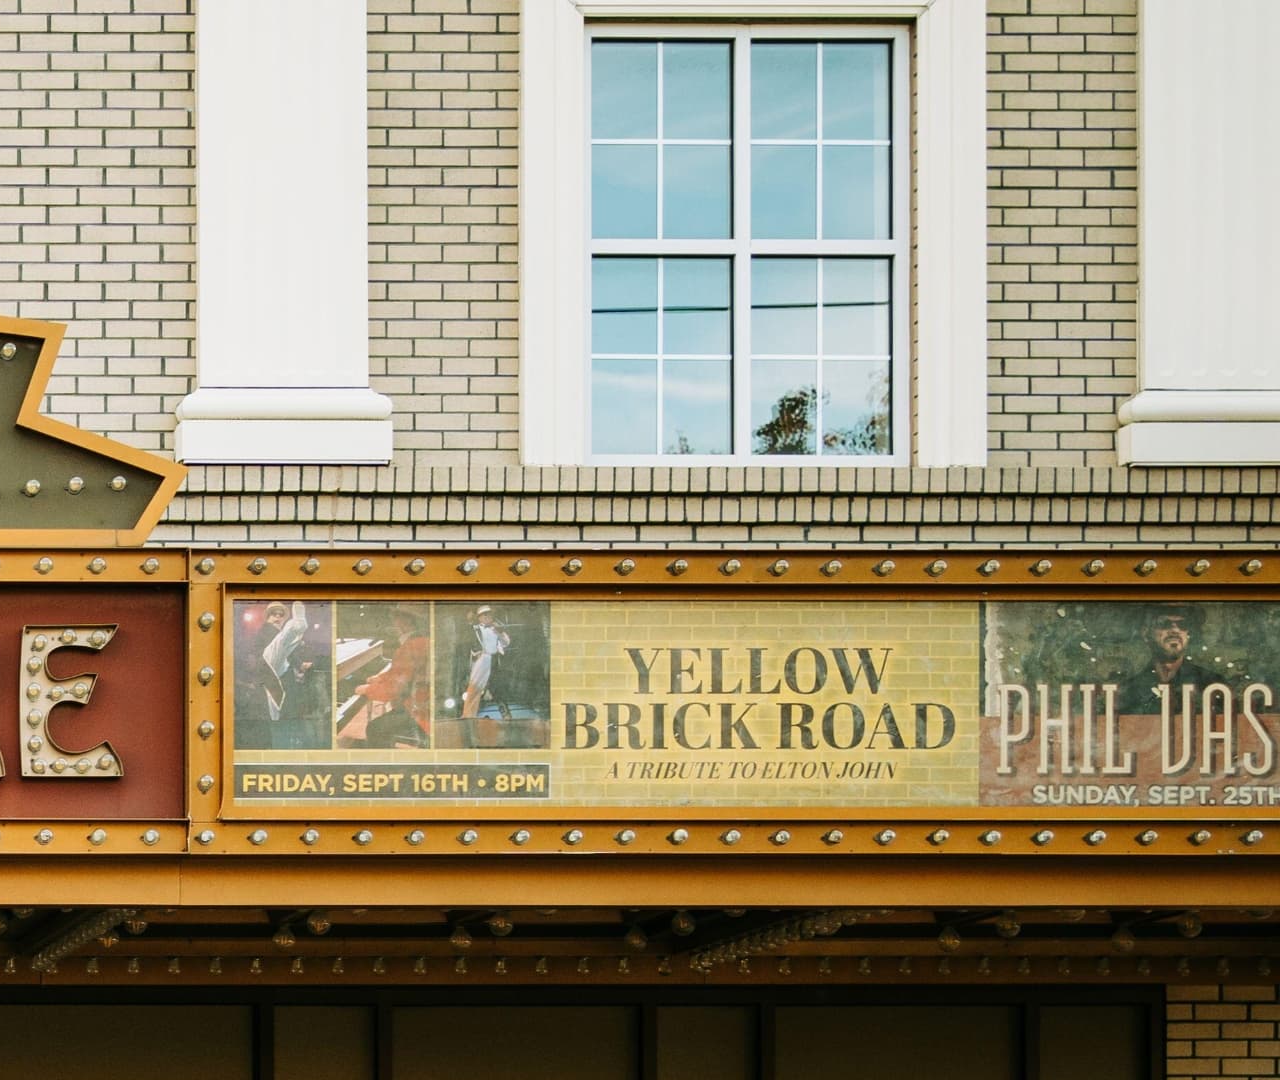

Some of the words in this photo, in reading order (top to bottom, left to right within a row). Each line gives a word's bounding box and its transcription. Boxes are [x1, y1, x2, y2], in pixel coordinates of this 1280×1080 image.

[624, 647, 892, 695] YELLOW
[561, 702, 761, 750] BRICK
[776, 702, 956, 751] ROAD
[996, 683, 1140, 778] PHIL
[242, 773, 335, 796] FRIDAY,
[343, 773, 404, 796] SEPT
[411, 773, 469, 796] 16TH
[495, 773, 545, 796] 8PM
[604, 761, 618, 780] A
[627, 761, 723, 780] TRIBUTE
[727, 761, 757, 780] TO
[760, 761, 834, 780] ELTON
[836, 761, 899, 780] JOHN
[1033, 784, 1139, 807] SUNDAY,
[1147, 784, 1216, 807] SEPT.
[1224, 784, 1280, 807] 25TH
